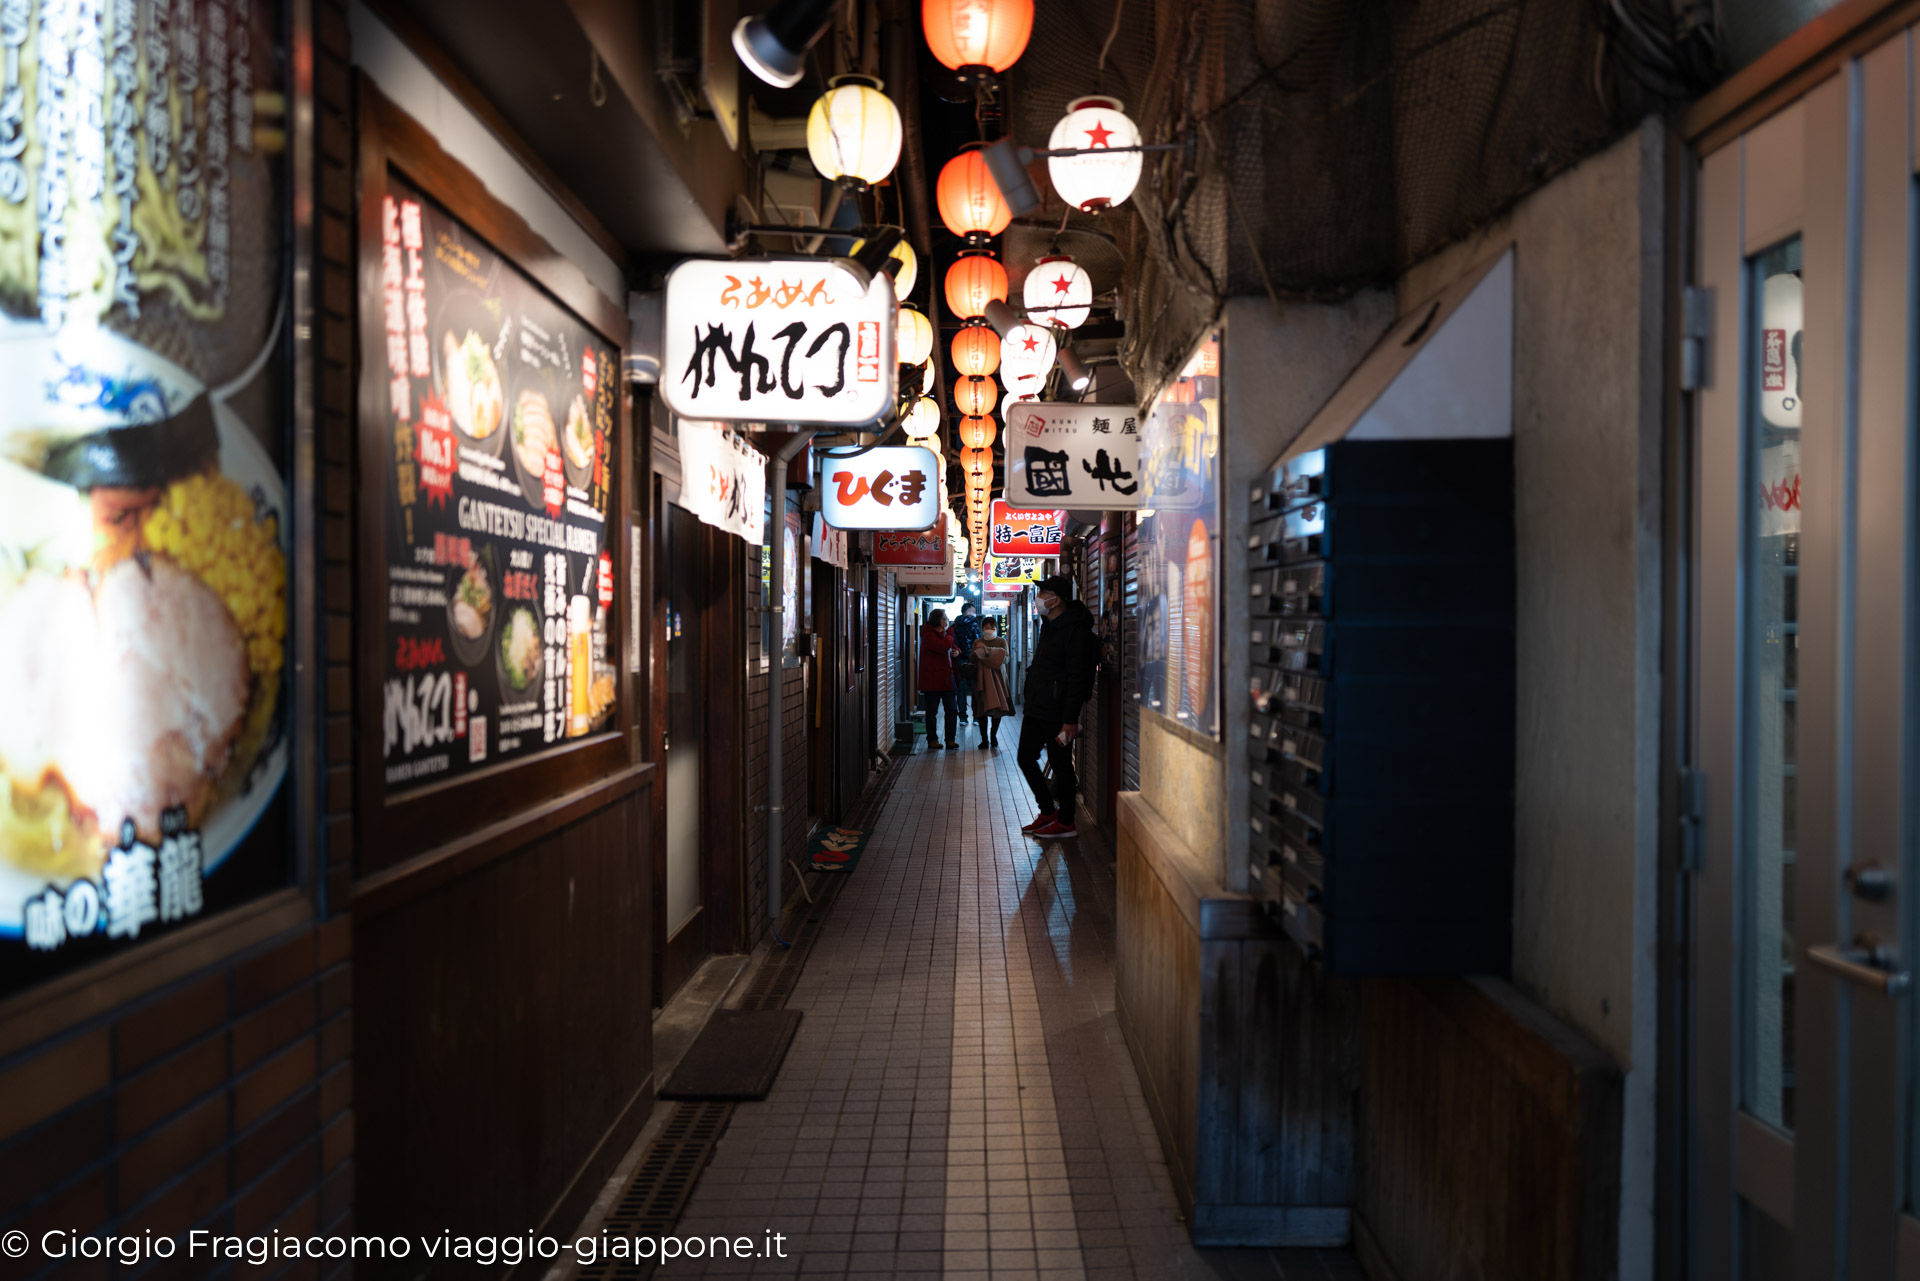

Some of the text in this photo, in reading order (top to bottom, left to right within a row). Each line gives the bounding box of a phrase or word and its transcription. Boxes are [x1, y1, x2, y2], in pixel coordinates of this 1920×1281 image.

[720, 275, 835, 309] らあめん
[832, 469, 927, 507] ひぐま
[458, 496, 525, 541] GANTETSU
[525, 513, 567, 550] SPECIAL
[566, 525, 598, 555] RAMEN
[995, 524, 1062, 544] 特一富屋
[878, 535, 942, 552] とらや食堂
